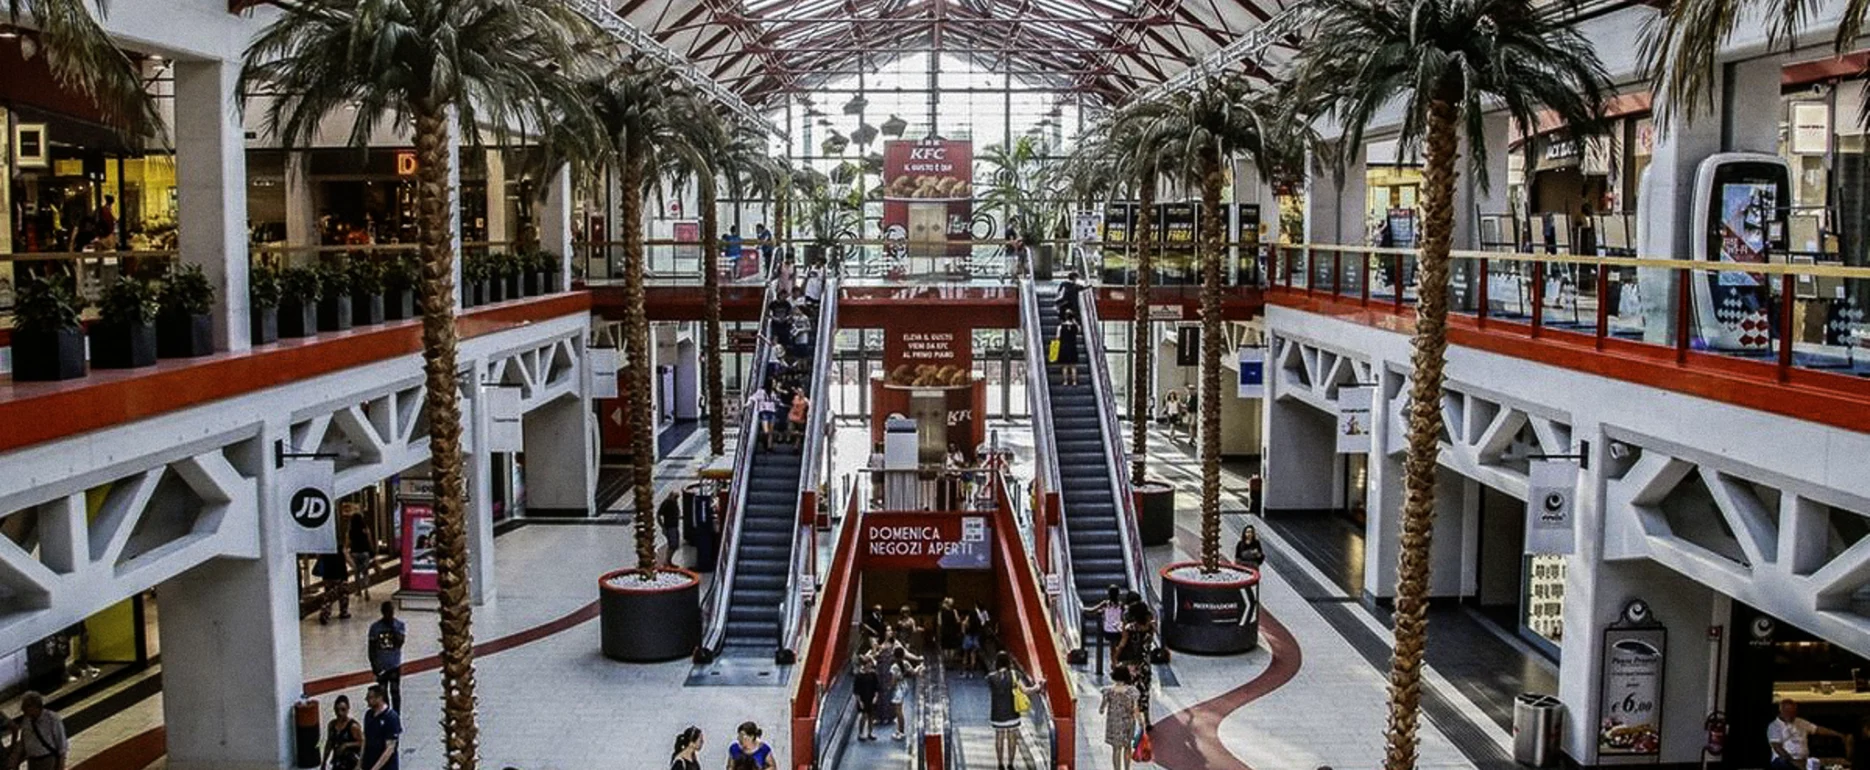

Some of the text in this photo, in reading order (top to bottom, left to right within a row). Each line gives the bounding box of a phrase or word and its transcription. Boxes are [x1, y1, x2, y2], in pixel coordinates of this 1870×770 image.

[910, 147, 947, 160] KFC
[936, 342, 949, 350] KFC
[295, 496, 327, 519] JD
[869, 526, 941, 541] DOMENICA
[869, 541, 973, 556] NEGOZI APERTI
[1622, 692, 1653, 714] 6,00
